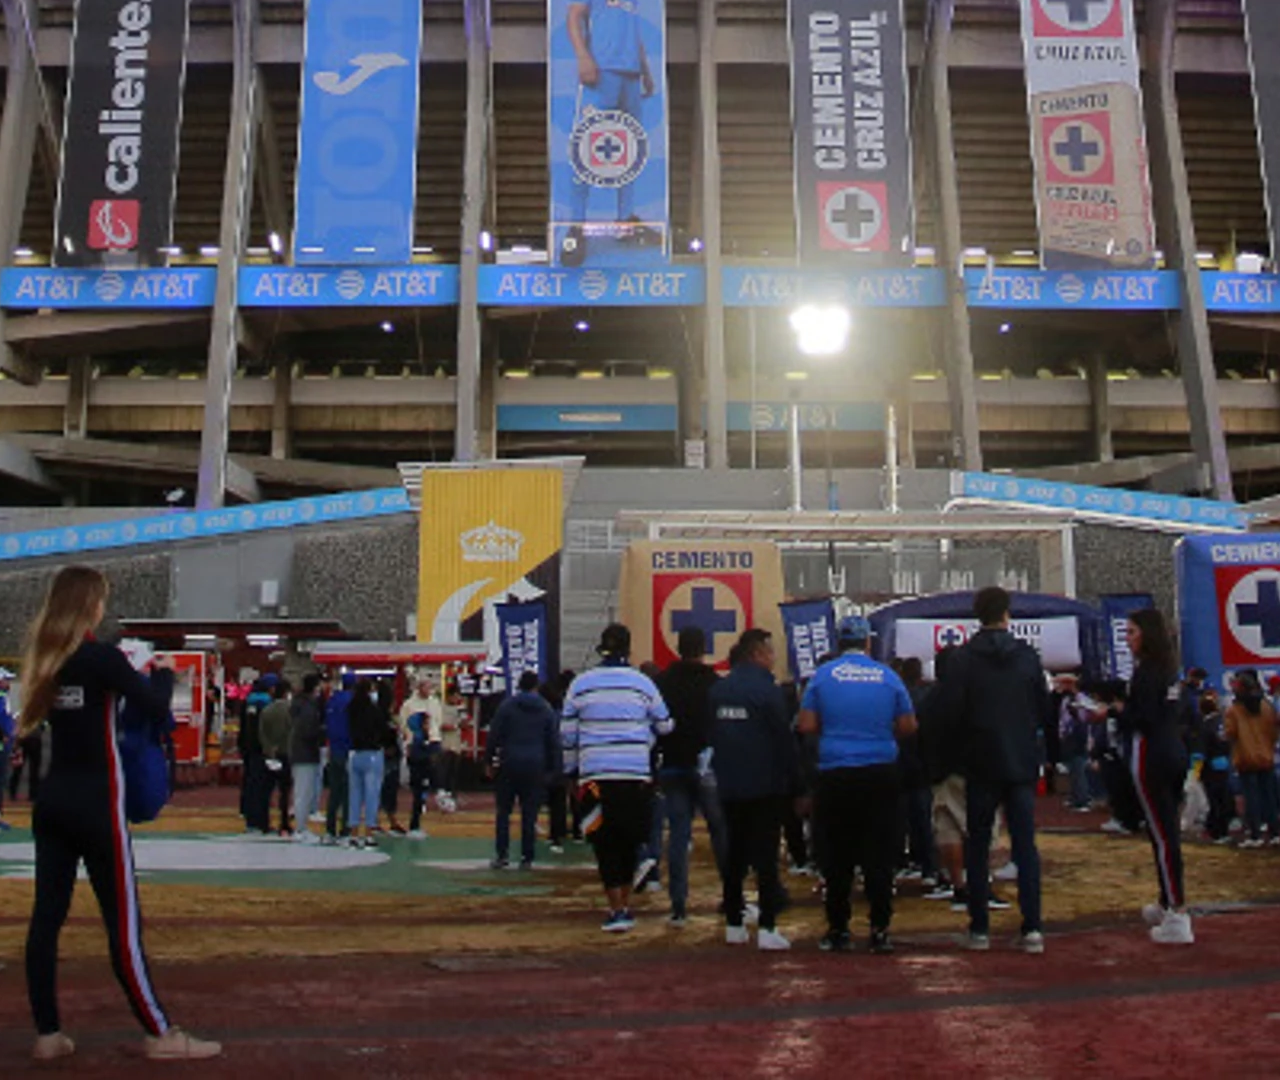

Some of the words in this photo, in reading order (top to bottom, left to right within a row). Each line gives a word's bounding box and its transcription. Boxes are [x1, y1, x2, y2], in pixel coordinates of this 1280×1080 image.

[850, 11, 883, 88] AZUL
[809, 12, 847, 170] CEMENTO
[853, 91, 887, 170] CRUZ
[16, 275, 86, 299] AT&T
[131, 274, 202, 298] AT&T
[254, 272, 326, 296] AT&T
[371, 272, 443, 296] AT&T
[496, 273, 568, 297] AT&T
[616, 273, 686, 297] AT&T
[857, 274, 924, 298] AT&T
[977, 276, 1047, 301] AT&T
[1091, 277, 1159, 301] AT&T
[1212, 279, 1278, 304] AT&T
[652, 552, 753, 569] CEMENTO
